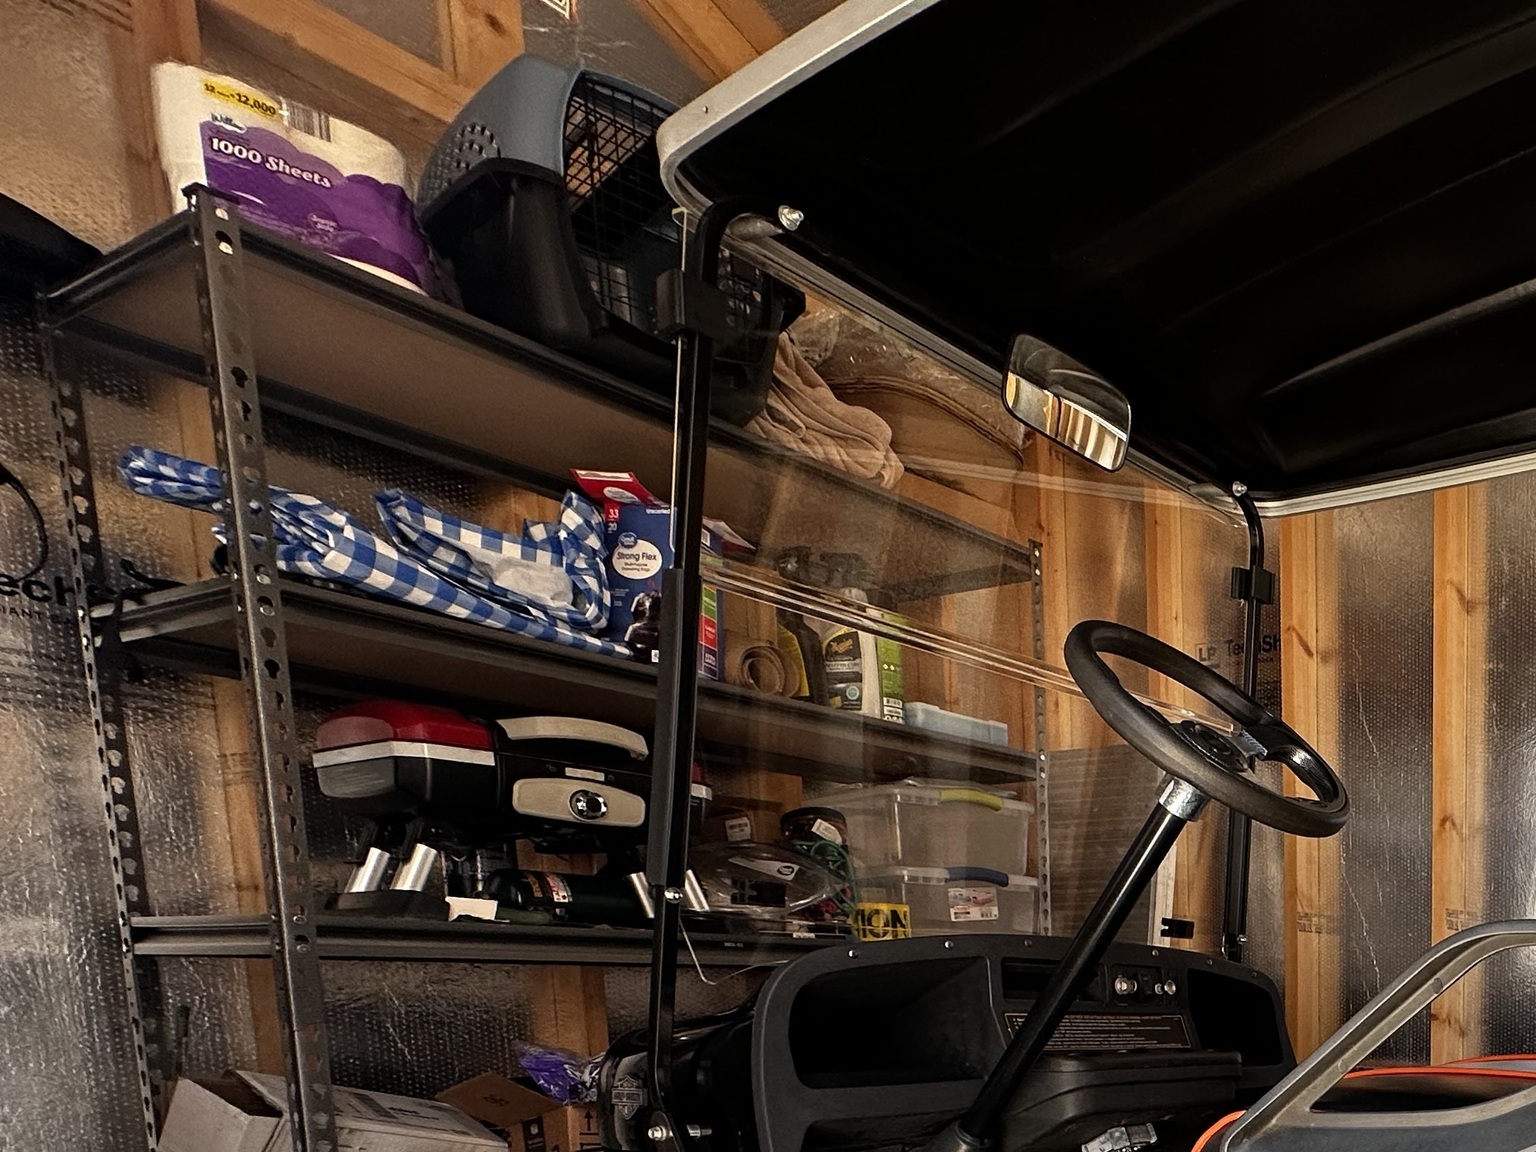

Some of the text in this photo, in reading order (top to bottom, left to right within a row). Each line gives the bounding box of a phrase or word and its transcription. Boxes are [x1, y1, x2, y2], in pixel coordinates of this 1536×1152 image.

[236, 92, 277, 115] 12,000
[210, 136, 333, 189] 1000 Sheets
[616, 551, 657, 562] Strong Flex
